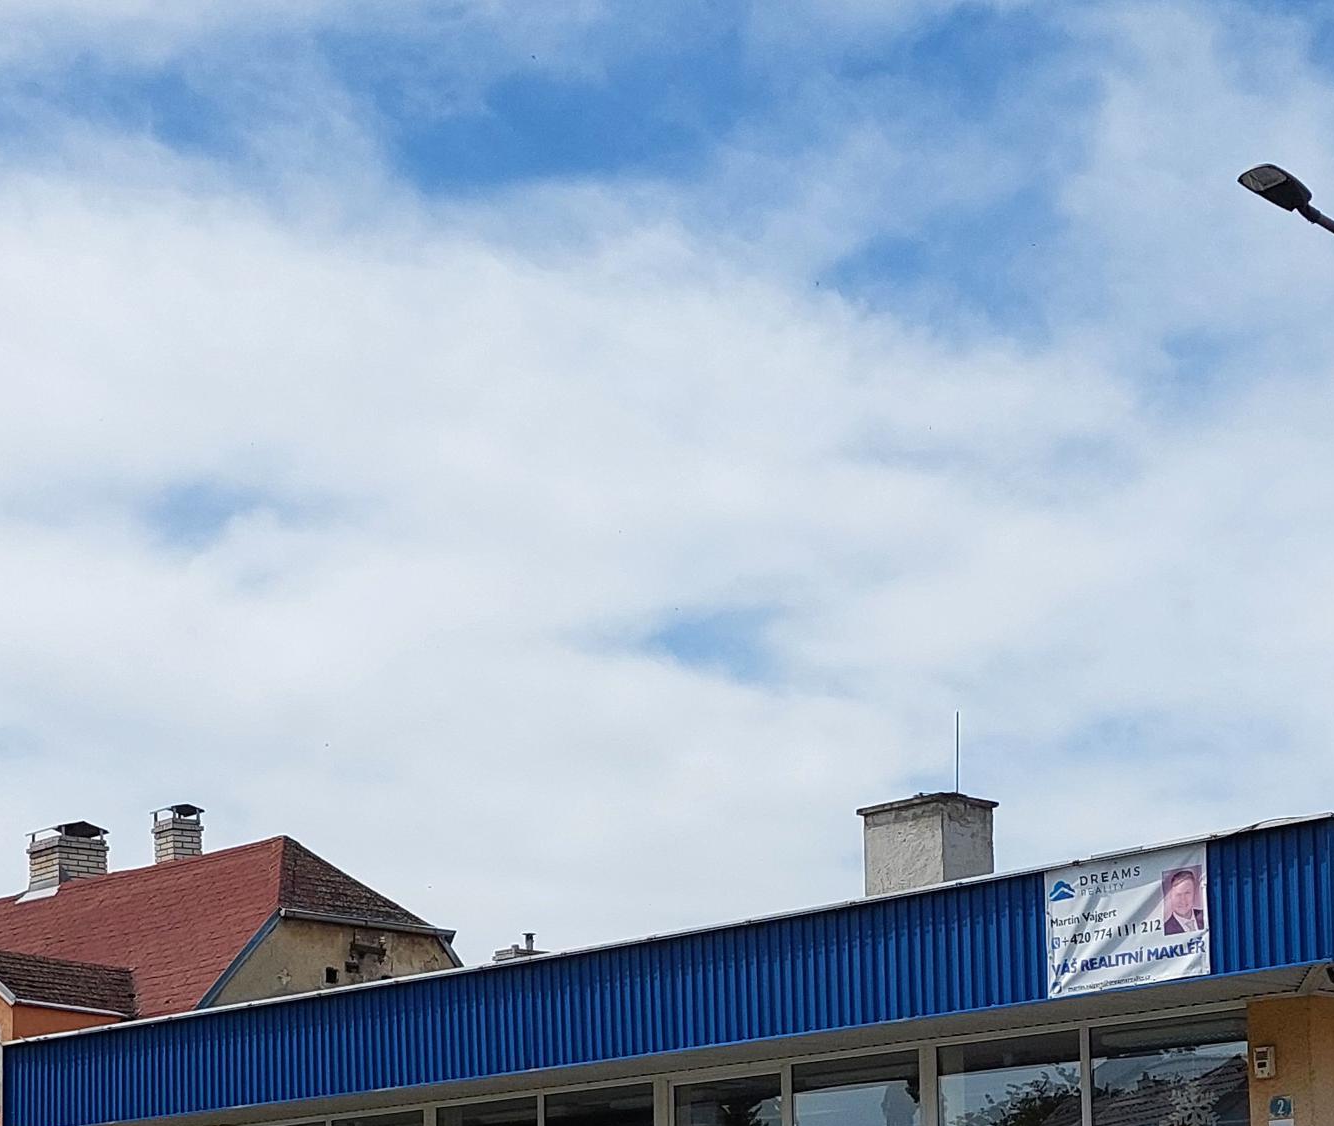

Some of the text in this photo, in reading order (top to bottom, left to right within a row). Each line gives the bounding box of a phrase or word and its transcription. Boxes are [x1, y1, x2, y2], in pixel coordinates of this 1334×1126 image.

[1079, 866, 1141, 887] DREAMS
[1081, 882, 1125, 897] REALITY
[1051, 909, 1117, 928] Martin Vajgert
[1061, 919, 1162, 945] +420 774 111 212
[1052, 937, 1206, 977] VÁŠ REALITNÍ MAKLÉŘ
[1277, 1099, 1285, 1114] 2
